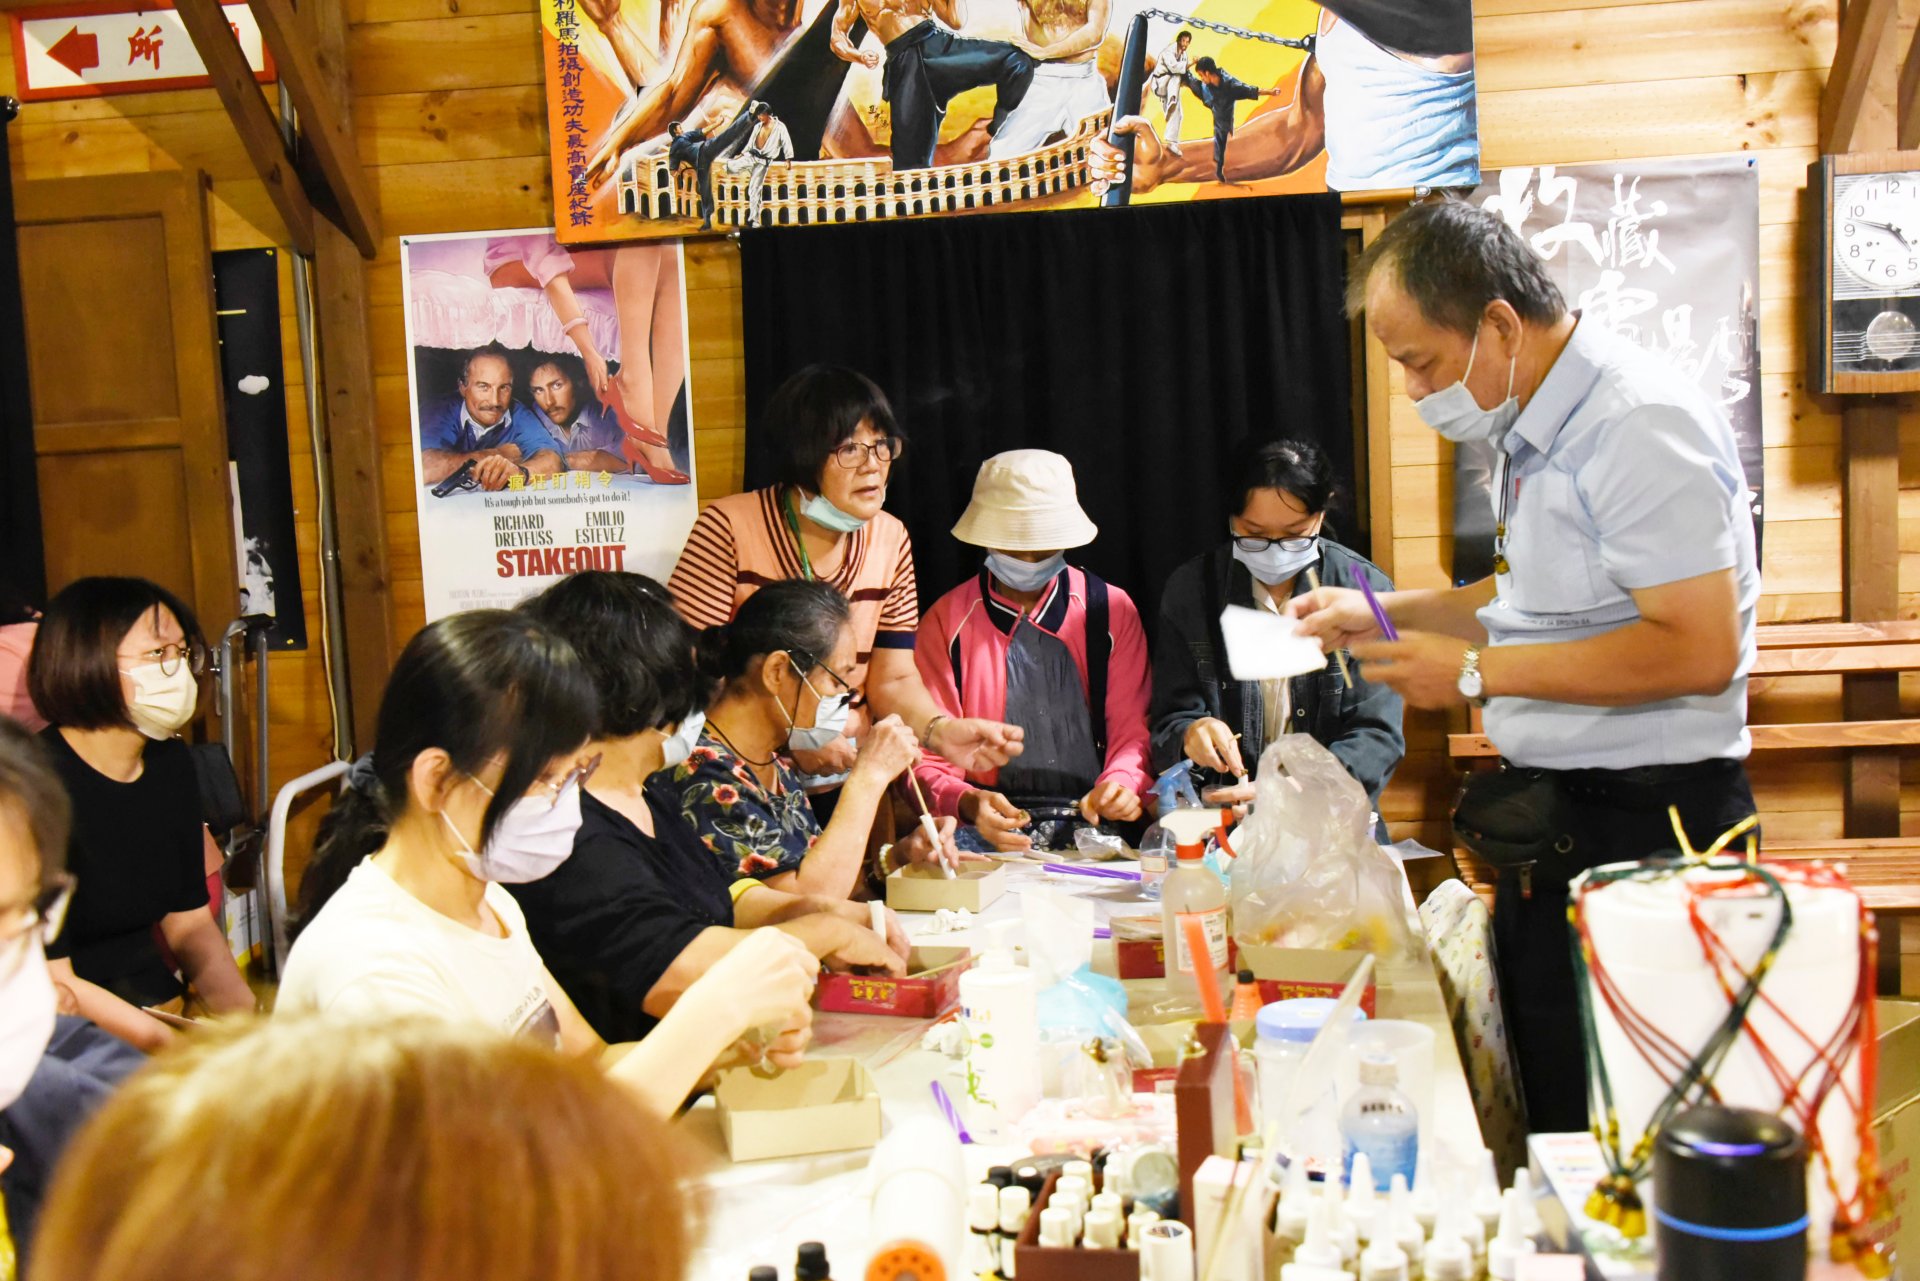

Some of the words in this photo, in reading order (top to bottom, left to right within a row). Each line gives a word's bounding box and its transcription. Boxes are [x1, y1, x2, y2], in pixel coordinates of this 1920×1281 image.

[1886, 180, 1900, 194] 12
[1866, 188, 1878, 201] 11
[1849, 205, 1865, 218] 10
[1843, 223, 1856, 238] 9
[1849, 244, 1861, 258] 8
[1865, 259, 1876, 272] 7
[1885, 264, 1898, 278] 6
[1907, 257, 1918, 271] 5
[484, 496, 494, 508] It's
[500, 496, 521, 509] tough
[521, 495, 533, 508] job
[534, 495, 546, 506] but
[547, 492, 588, 505] somebody's
[588, 493, 600, 504] got
[602, 493, 610, 502] to
[611, 490, 620, 501] do
[621, 489, 631, 501] it!
[493, 514, 544, 531] RICHARD
[585, 510, 625, 527] EMILIO
[495, 530, 553, 547] DREYFUSS
[575, 527, 626, 544] ESTEVEZ
[496, 545, 626, 577] STAKEOUT
